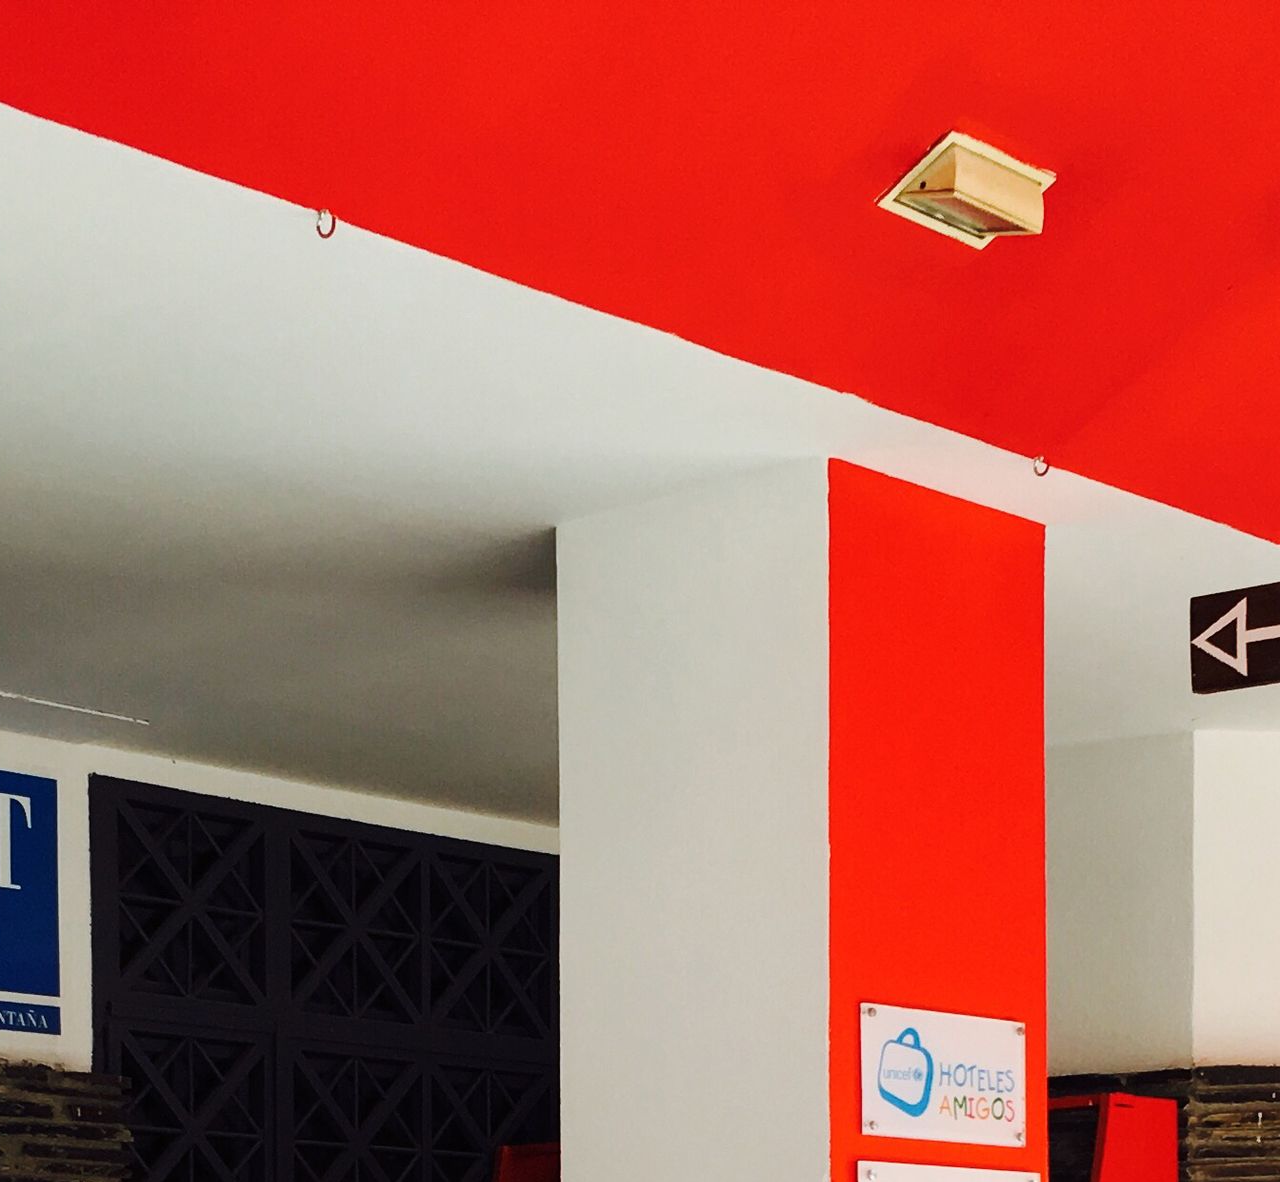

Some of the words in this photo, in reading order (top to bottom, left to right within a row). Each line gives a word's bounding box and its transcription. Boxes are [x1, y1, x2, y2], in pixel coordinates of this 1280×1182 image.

[883, 1067, 913, 1081] unicef
[939, 1062, 1016, 1094] HOTELES
[939, 1095, 1016, 1122] AMIGOS
